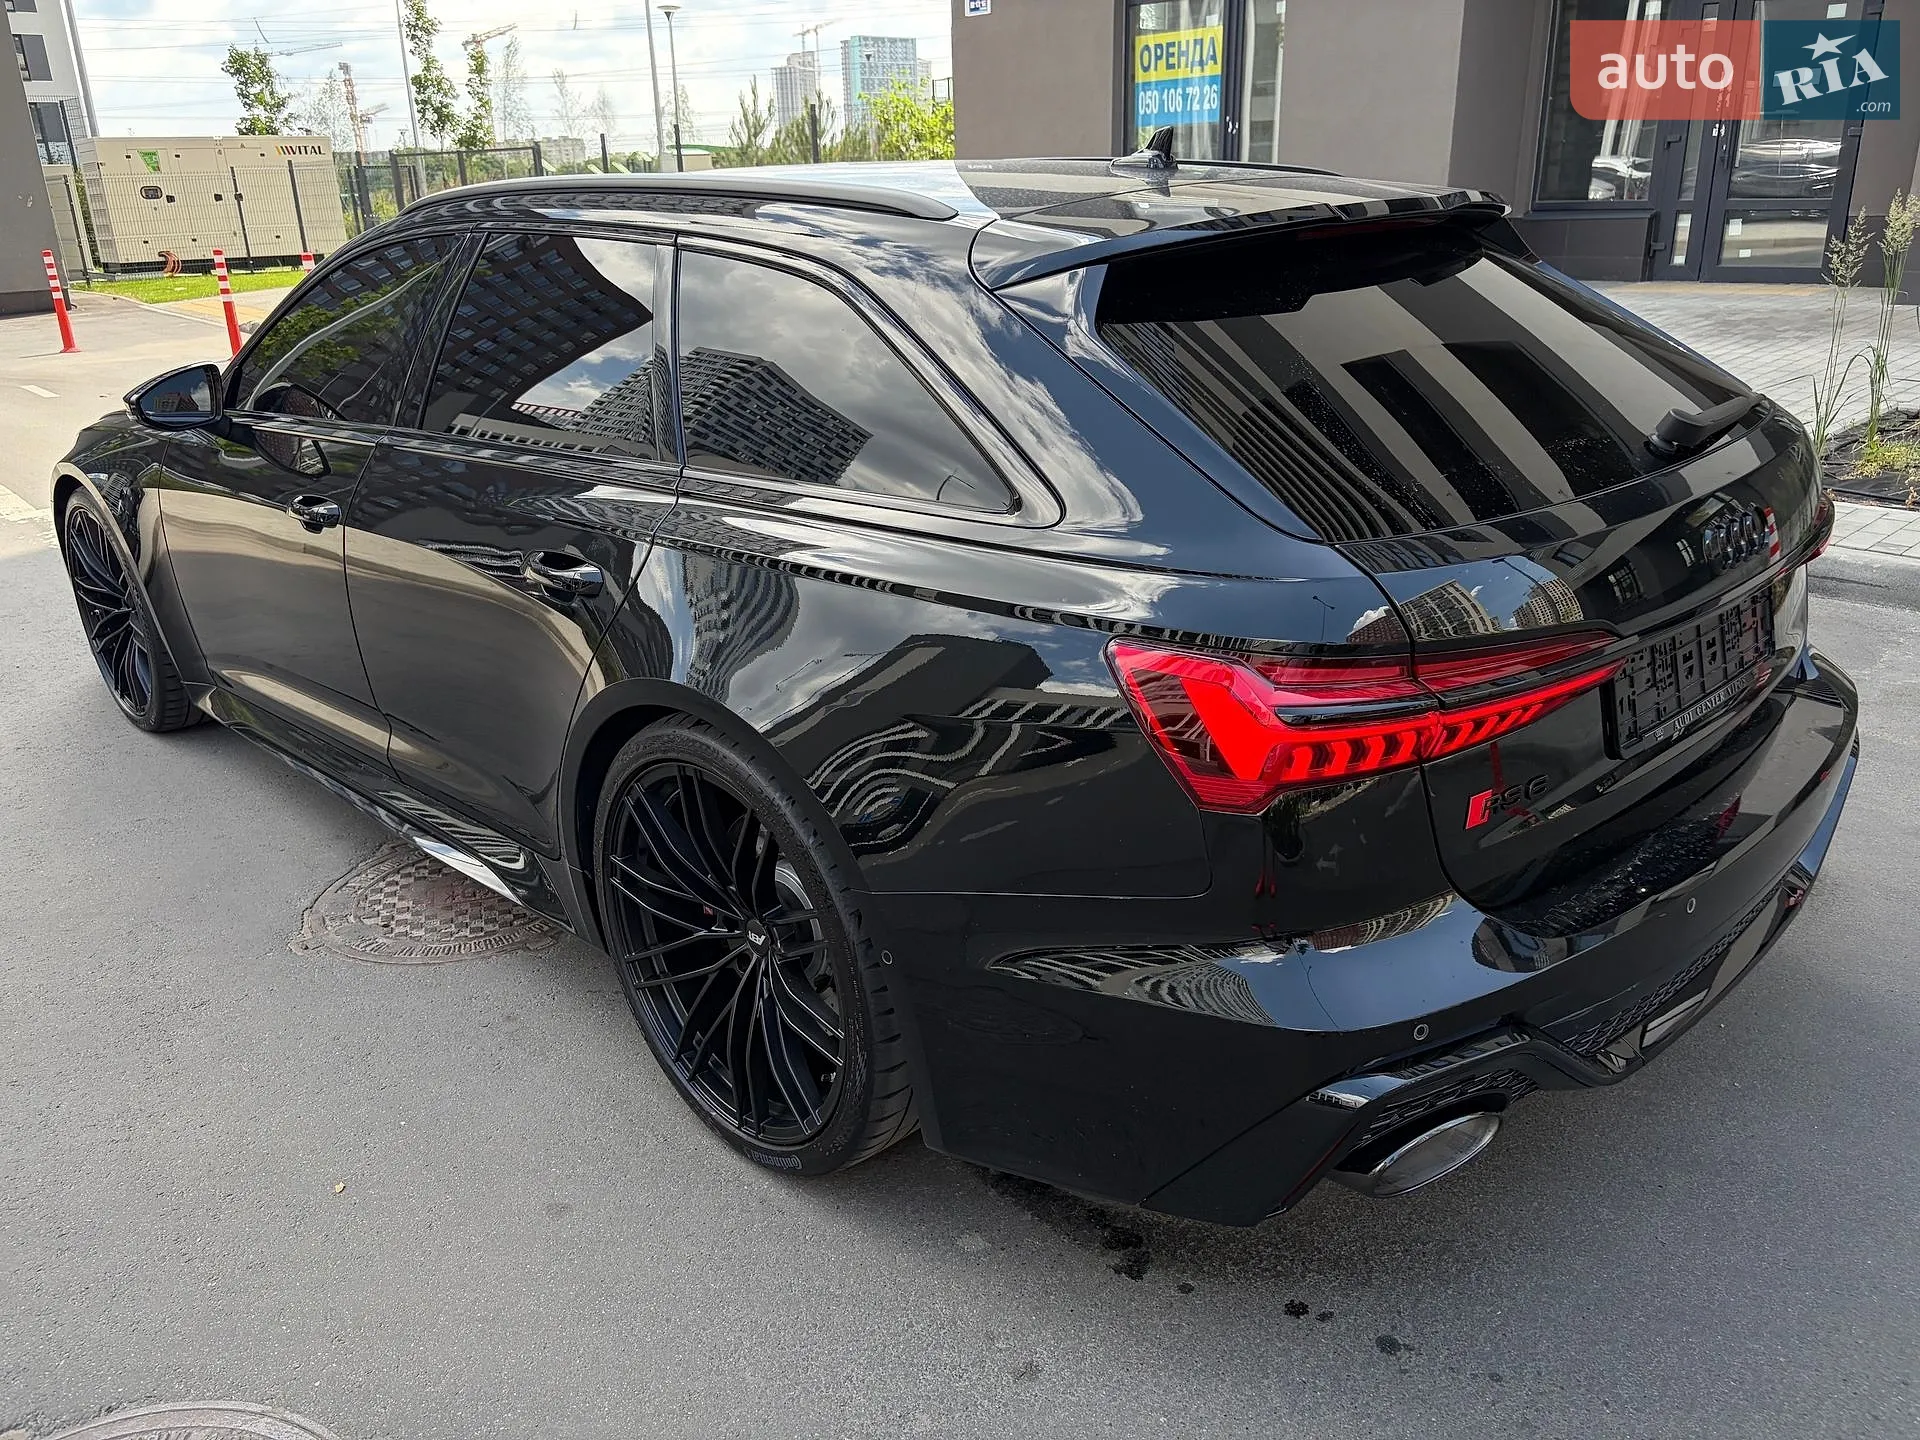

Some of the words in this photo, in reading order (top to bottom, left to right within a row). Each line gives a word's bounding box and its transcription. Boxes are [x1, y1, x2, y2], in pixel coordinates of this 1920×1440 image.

[1139, 36, 1219, 74] ОРЕНДА
[1138, 90, 1159, 115] 050
[1162, 87, 1183, 113] 106
[1186, 85, 1200, 111] 72
[1203, 83, 1218, 110] 26
[288, 145, 326, 155] VITAL
[1674, 710, 1694, 732] AUDI
[1696, 692, 1725, 717] CENTER
